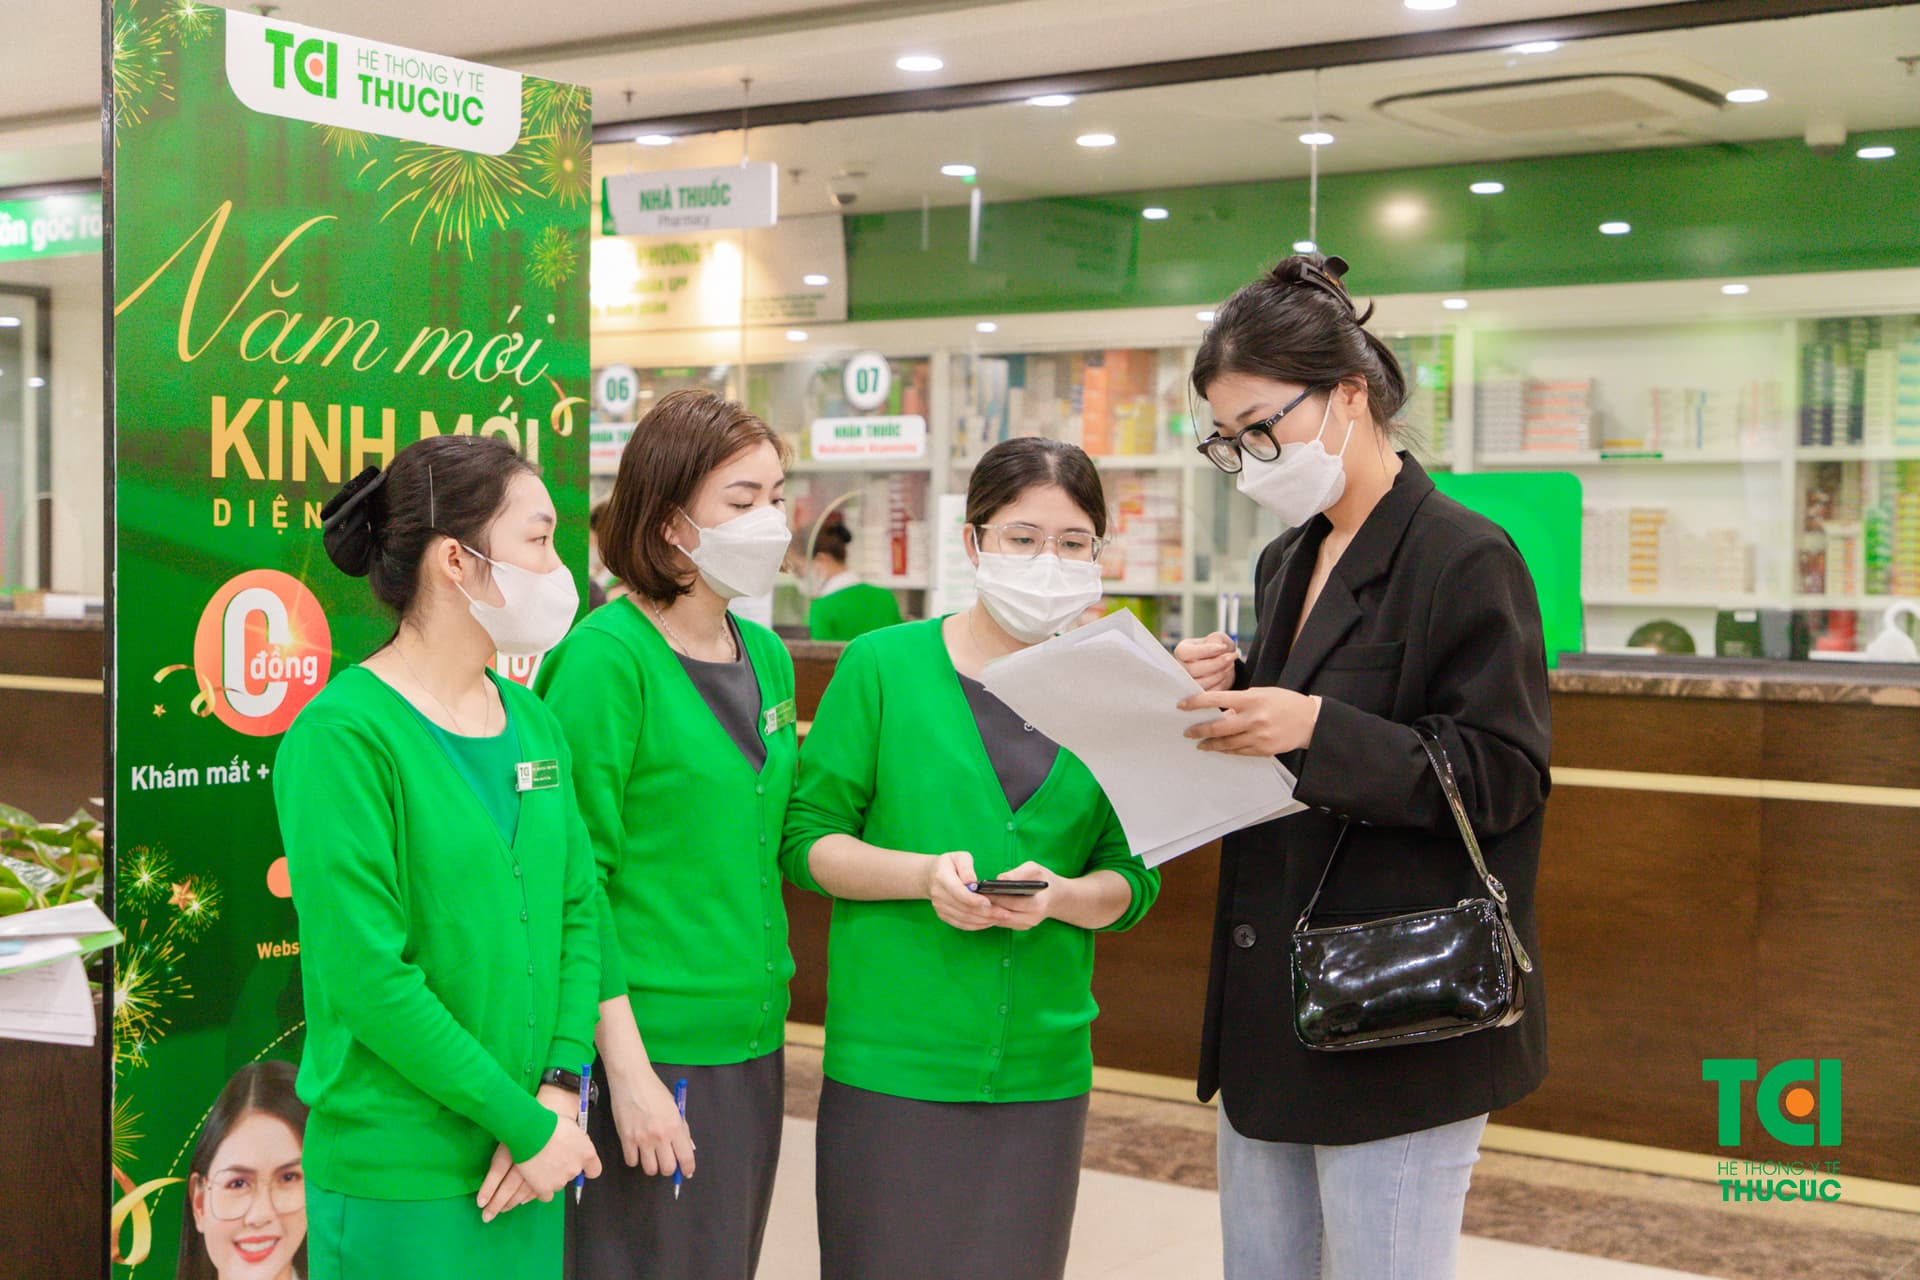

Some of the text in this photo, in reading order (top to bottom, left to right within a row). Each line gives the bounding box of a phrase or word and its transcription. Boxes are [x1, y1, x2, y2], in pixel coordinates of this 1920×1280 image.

[265, 28, 338, 99] TCI
[453, 68, 464, 88] Y
[114, 199, 555, 386] Năm mới
[606, 377, 629, 402] 06
[856, 366, 880, 394] 07
[211, 375, 396, 484] KÍNH
[213, 494, 323, 535] DIỆN
[131, 762, 199, 791] Khám
[206, 754, 250, 785] mắt
[256, 939, 300, 960] Webs
